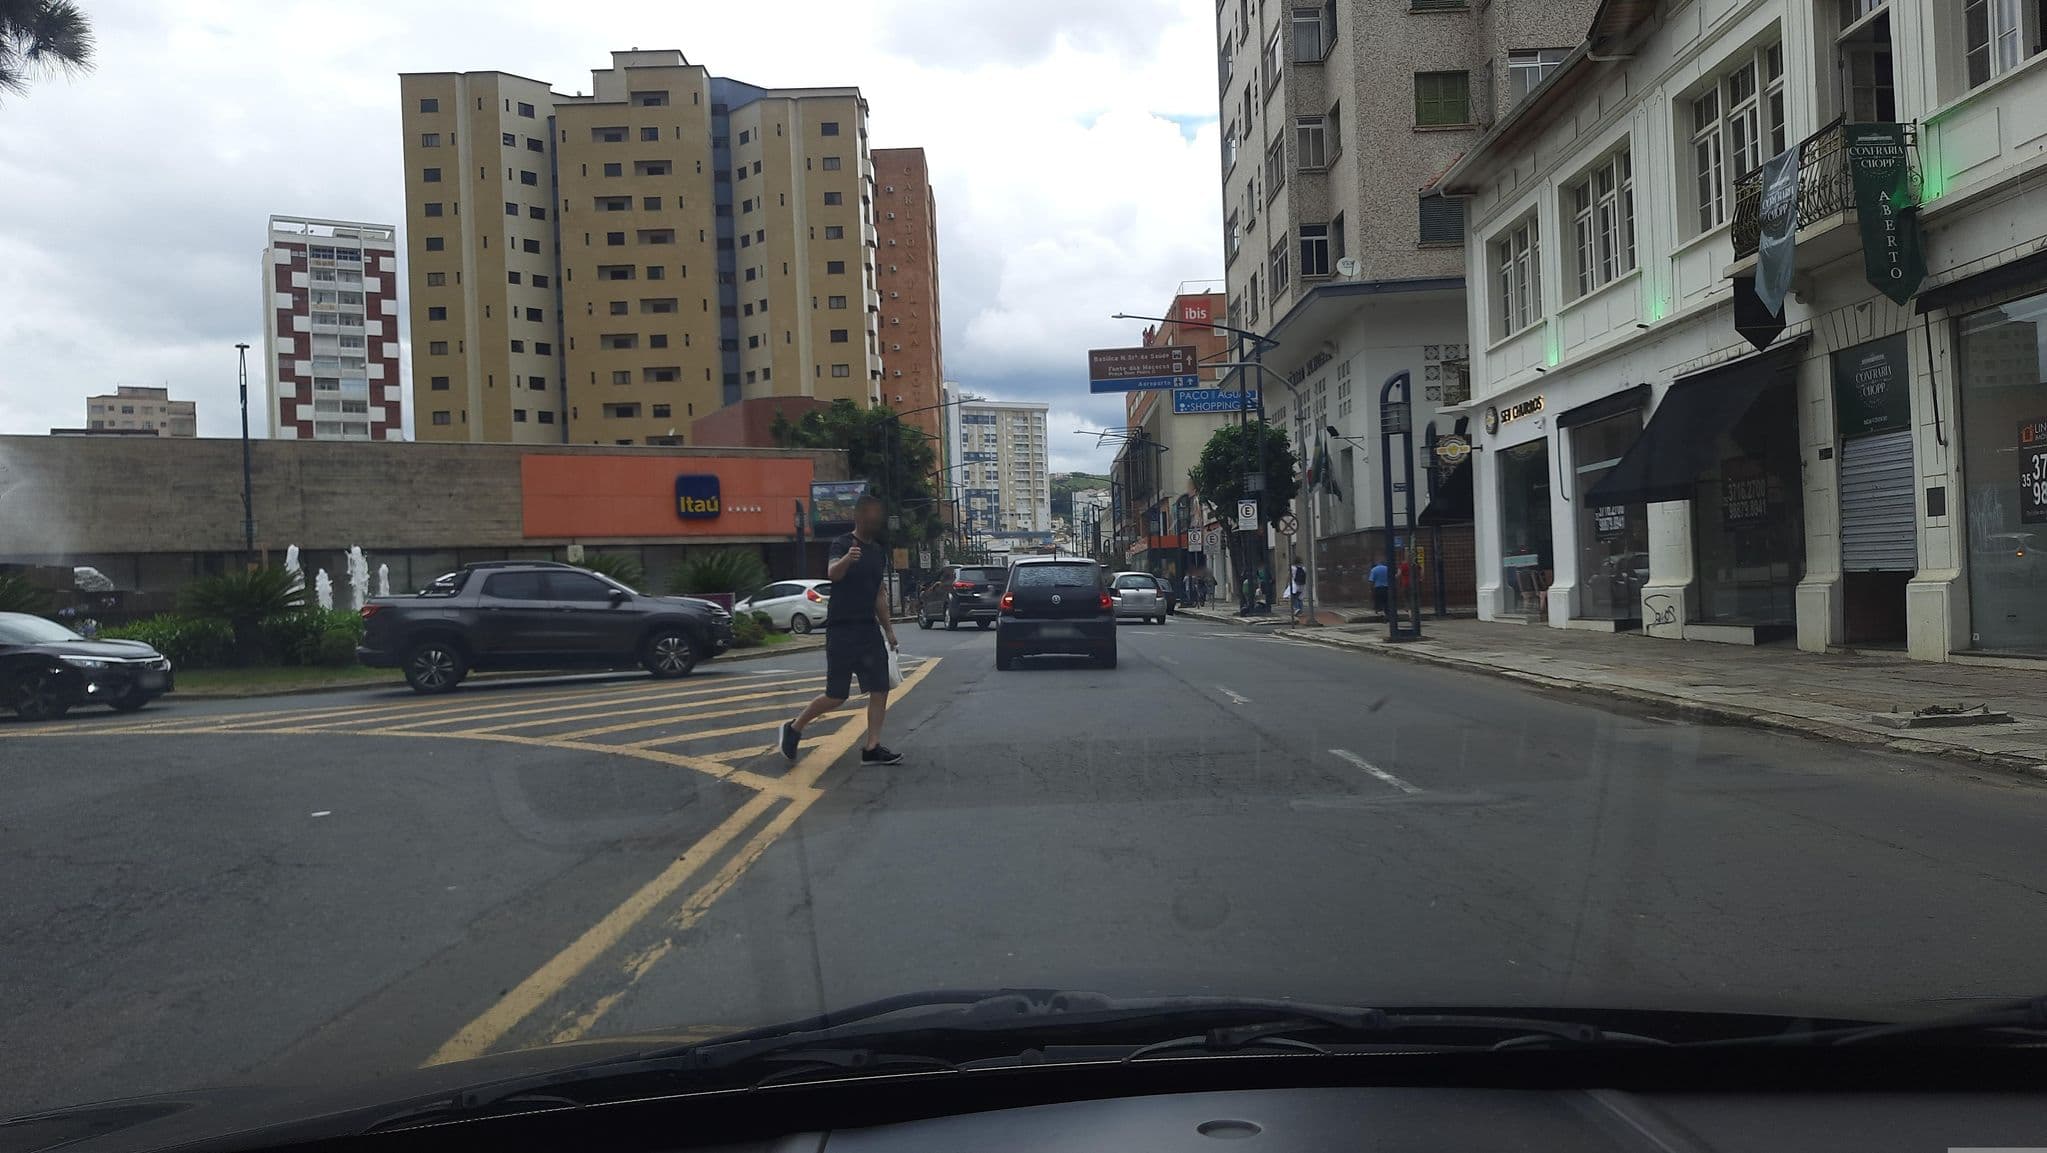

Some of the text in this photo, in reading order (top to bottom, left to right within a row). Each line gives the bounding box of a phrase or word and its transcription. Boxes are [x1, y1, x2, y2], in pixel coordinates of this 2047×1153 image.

[1849, 145, 1904, 156] CONFRARIA
[1860, 158, 1895, 168] CHOPP
[1767, 203, 1789, 221] CHOPP
[1879, 190, 1903, 280] ABERTO
[1185, 307, 1207, 320] ibis
[1217, 390, 1251, 399] AGUS
[1190, 401, 1241, 411] SHOPPING
[1512, 395, 1545, 420] CHURROS
[2021, 473, 2032, 488] 35
[680, 496, 719, 513] Itaú
[1244, 507, 1251, 515] E
